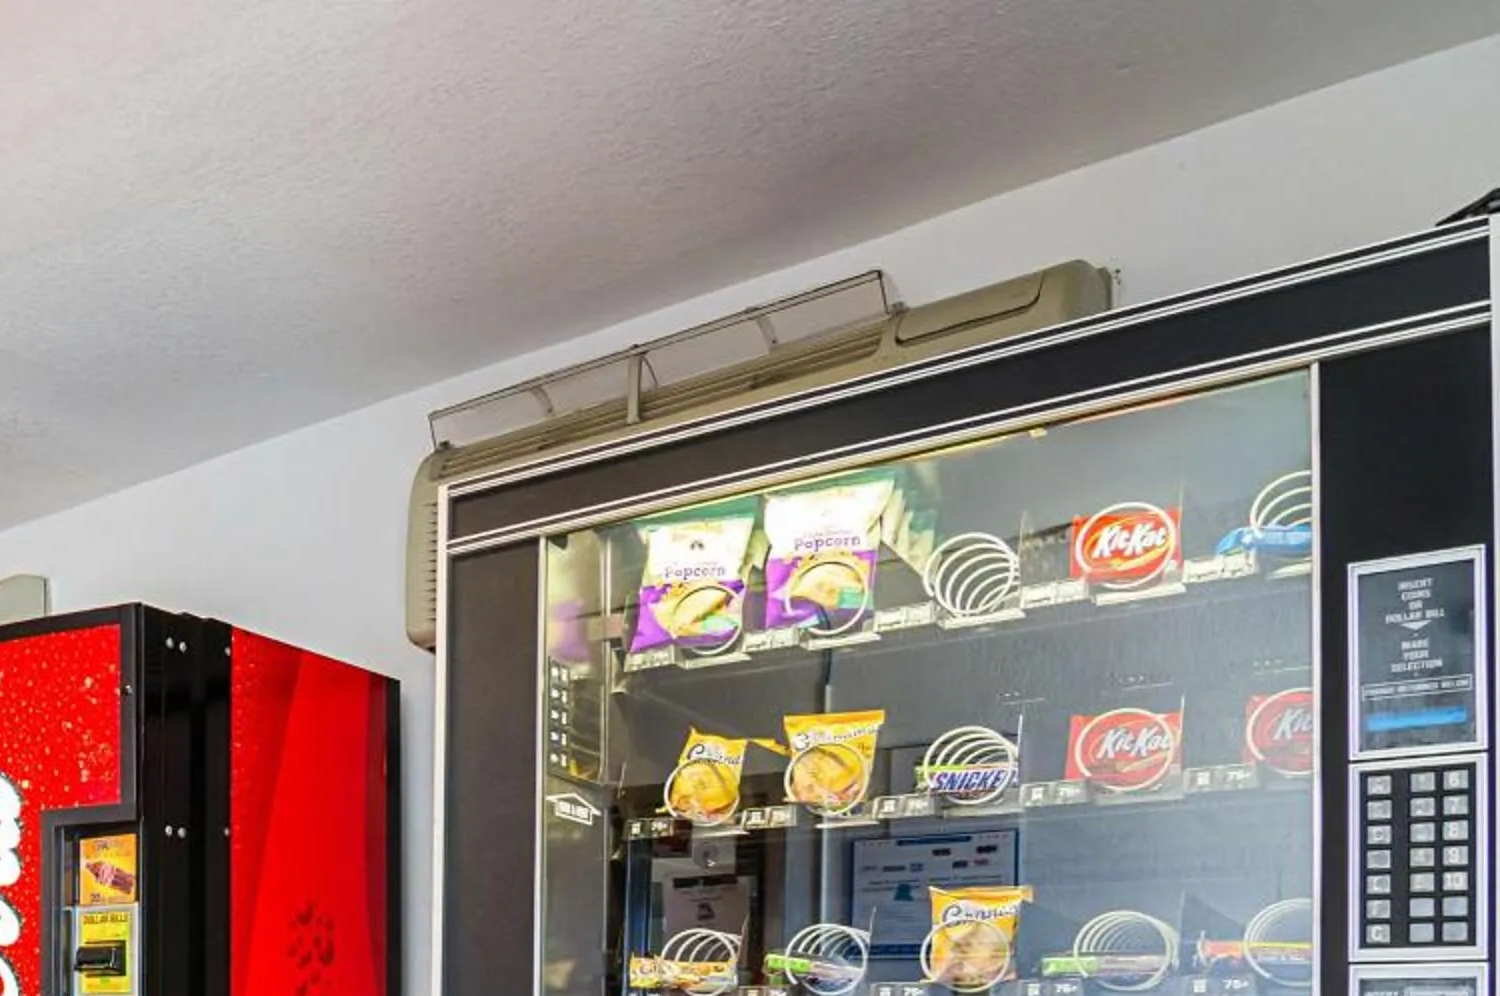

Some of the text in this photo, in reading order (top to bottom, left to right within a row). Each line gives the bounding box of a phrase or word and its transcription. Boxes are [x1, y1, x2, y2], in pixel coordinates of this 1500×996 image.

[794, 535, 861, 553] Popcorn
[664, 565, 727, 581] Popcorn
[1407, 600, 1423, 610] OR
